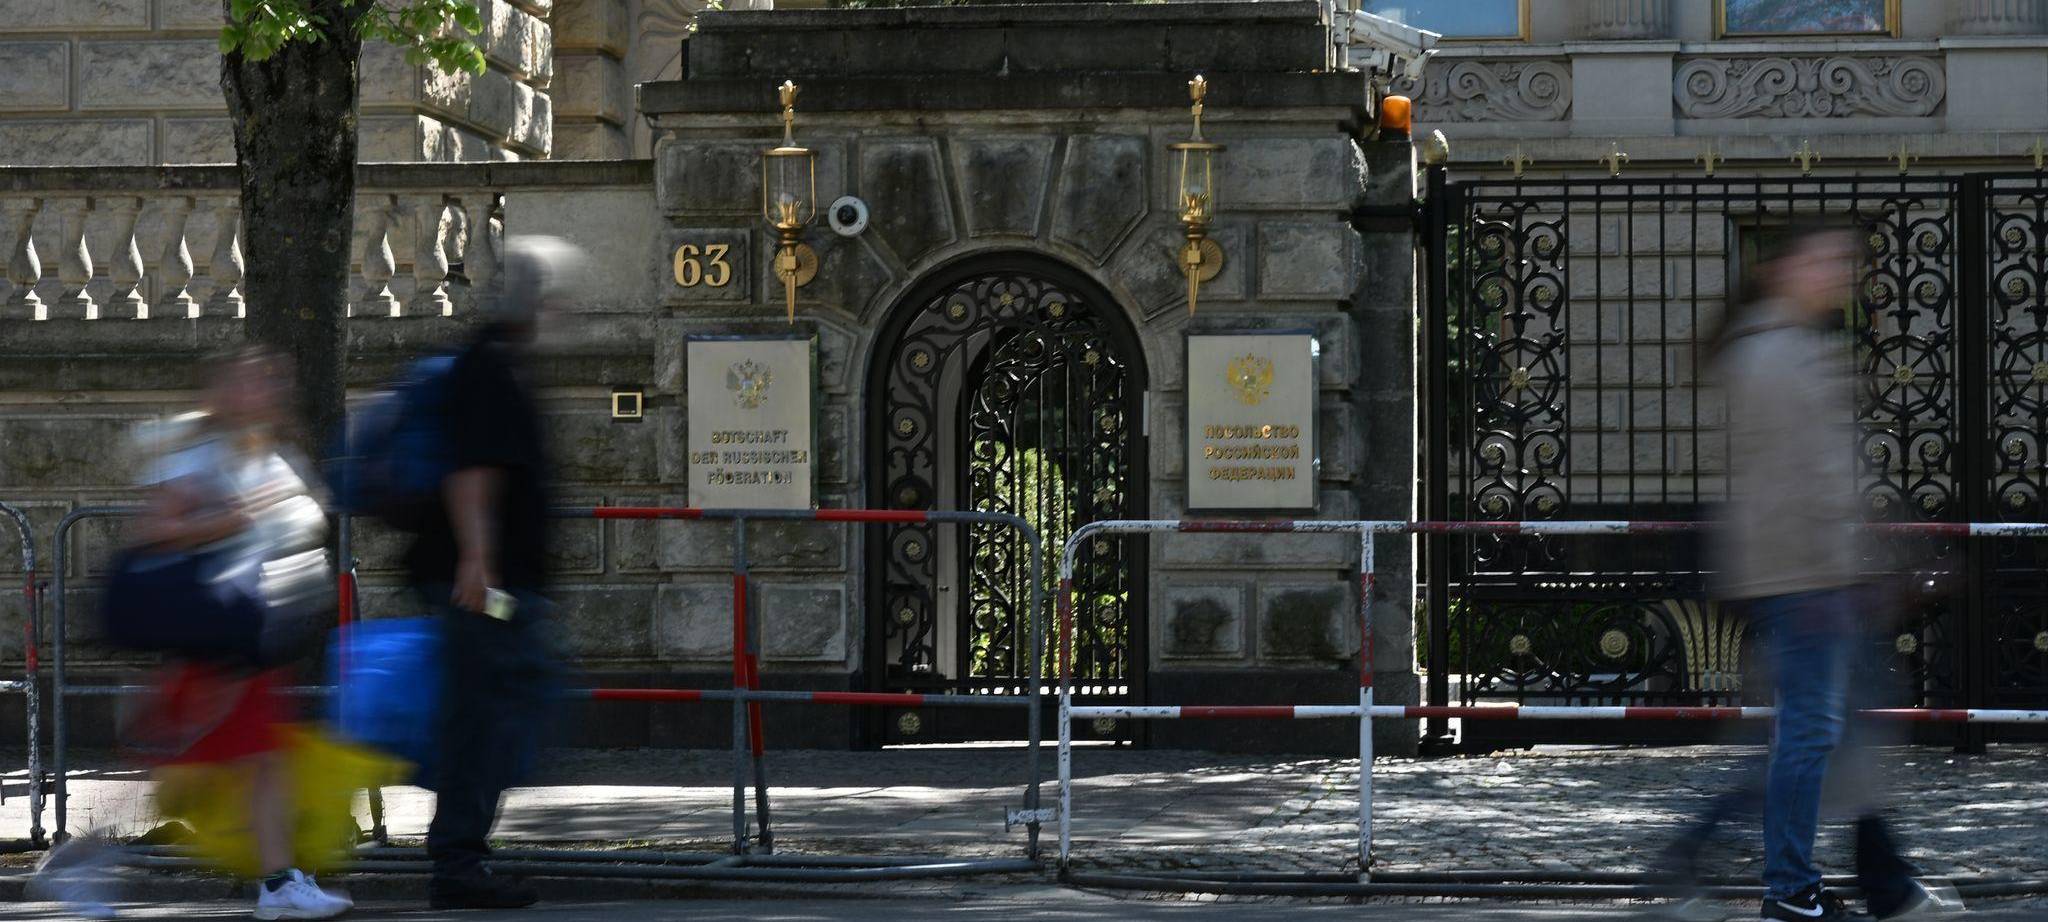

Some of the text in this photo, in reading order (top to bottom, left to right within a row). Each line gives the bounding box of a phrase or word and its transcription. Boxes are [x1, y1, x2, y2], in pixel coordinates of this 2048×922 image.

[674, 244, 731, 287] 63
[711, 430, 788, 444] BOTSCHAFT
[1204, 424, 1299, 439] ПОСОЛЬСТВО
[691, 450, 808, 465] DER RUSSISCHEN
[1204, 444, 1300, 460] РОССИЙСКОЙ
[707, 467, 793, 485] FÖDERATION
[1208, 466, 1296, 481] ФЕДЕРАЦИИ
